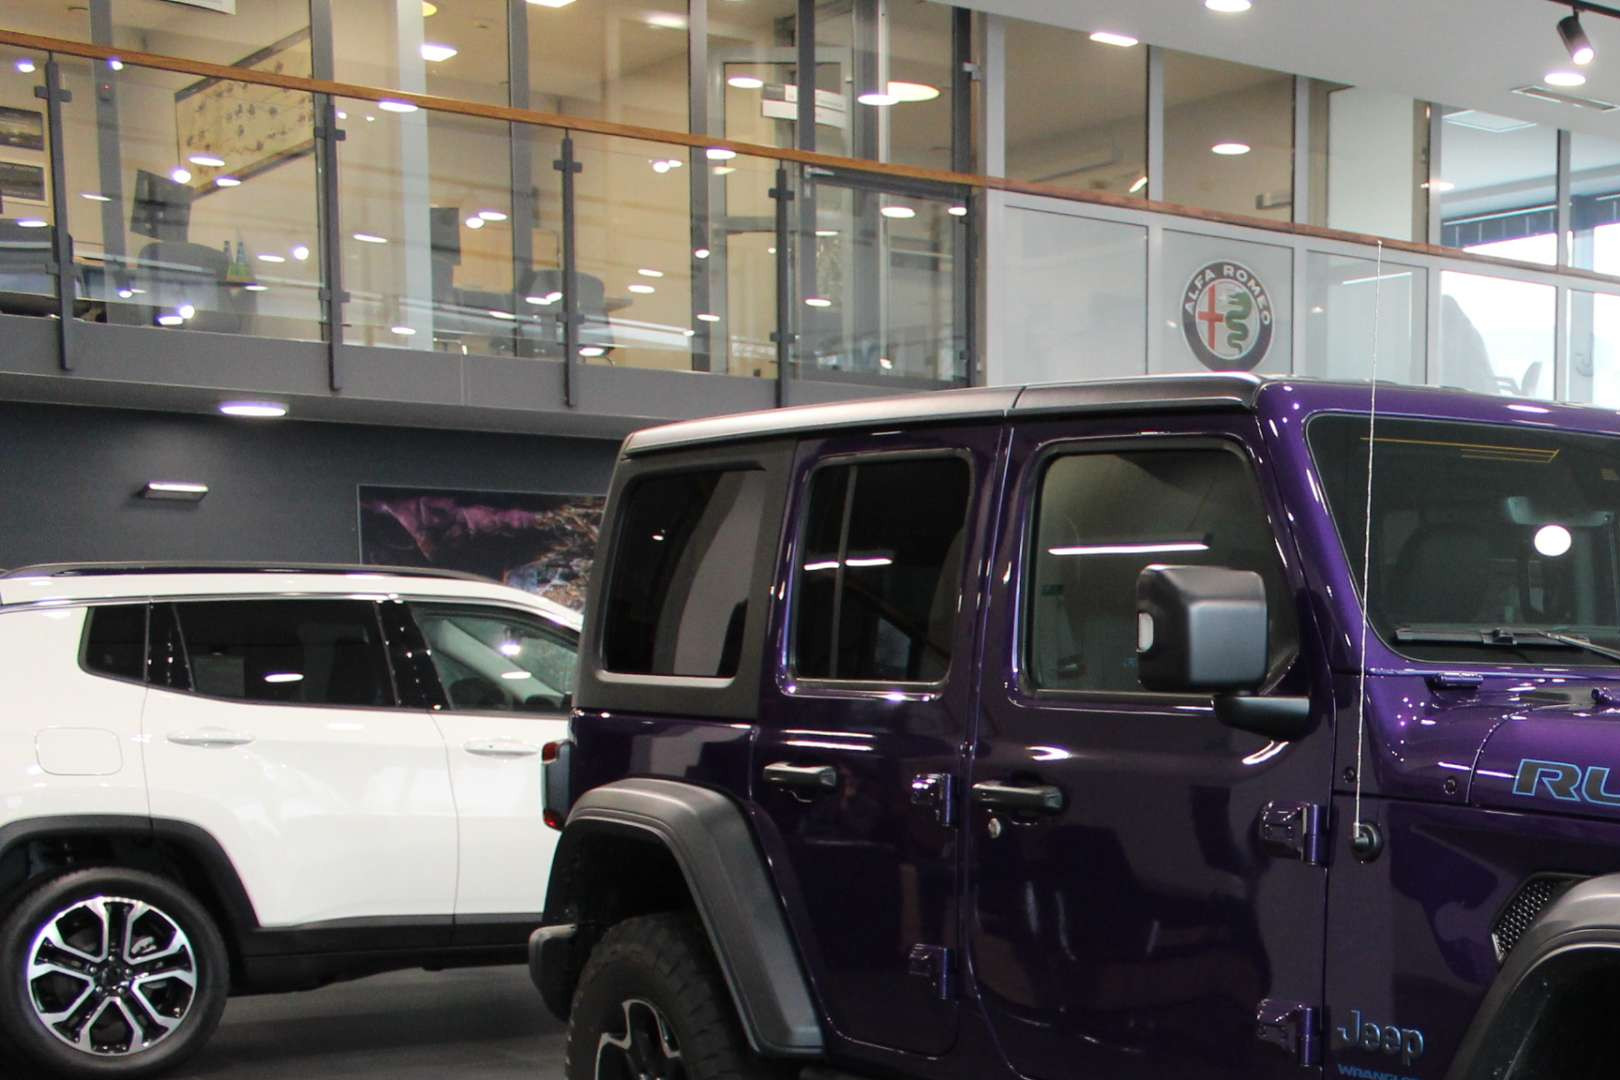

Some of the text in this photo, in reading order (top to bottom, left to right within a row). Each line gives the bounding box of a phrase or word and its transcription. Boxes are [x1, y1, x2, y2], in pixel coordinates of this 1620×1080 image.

[1184, 264, 1271, 325] ALFA ROMEO
[1336, 1009, 1424, 1067] Jeep
